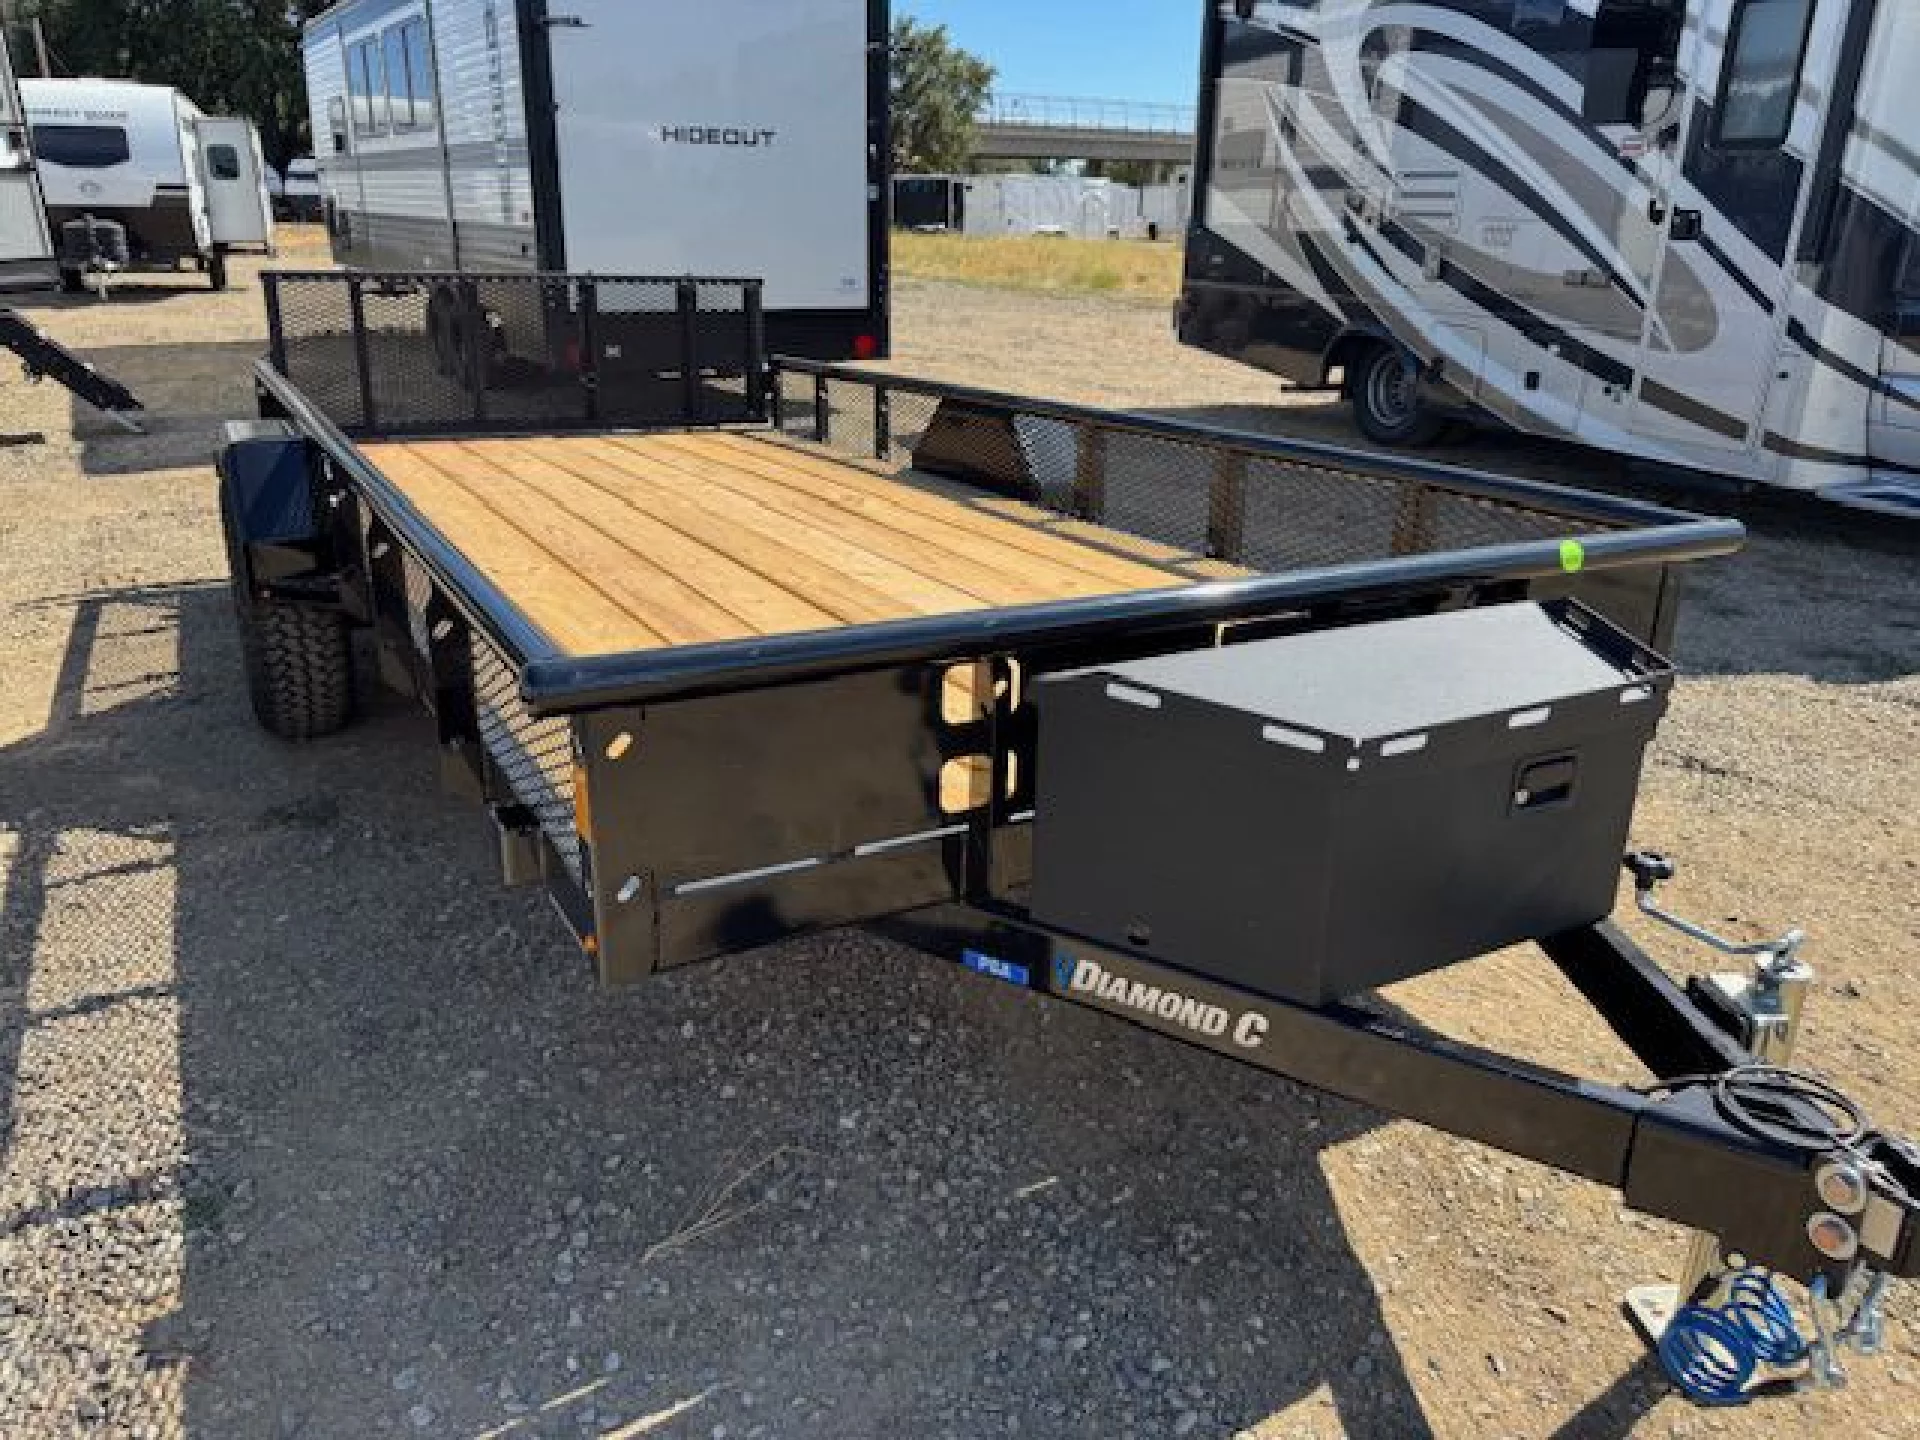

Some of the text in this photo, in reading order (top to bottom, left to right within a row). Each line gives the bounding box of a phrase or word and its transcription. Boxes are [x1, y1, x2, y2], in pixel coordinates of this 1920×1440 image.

[661, 125, 778, 148] HIDEOUT
[1070, 958, 1270, 1048] DIAMOND C
